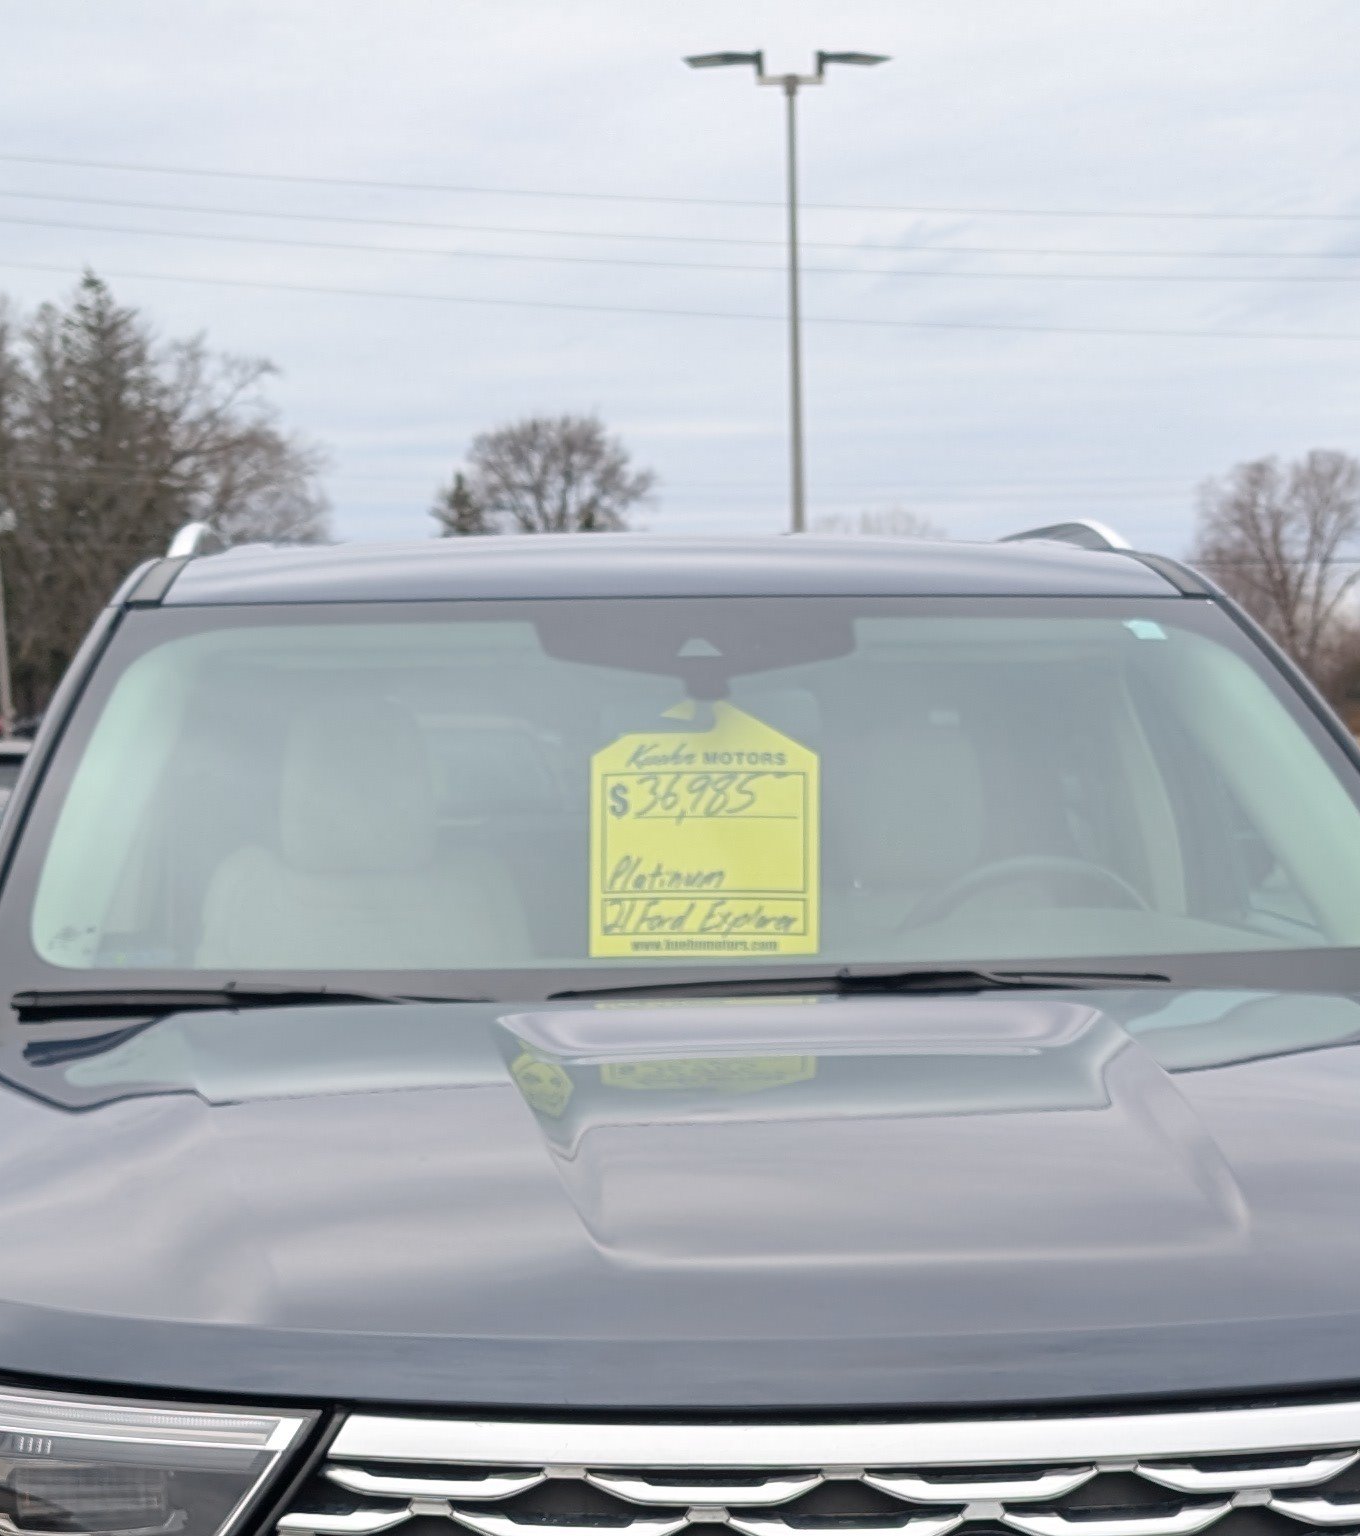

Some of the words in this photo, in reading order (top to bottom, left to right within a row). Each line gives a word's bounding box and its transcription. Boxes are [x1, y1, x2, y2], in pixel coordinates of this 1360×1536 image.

[703, 751, 787, 766] MOTORS
[608, 855, 725, 892] Platinum
[635, 898, 696, 933] Ford
[699, 898, 797, 937] Explorer
